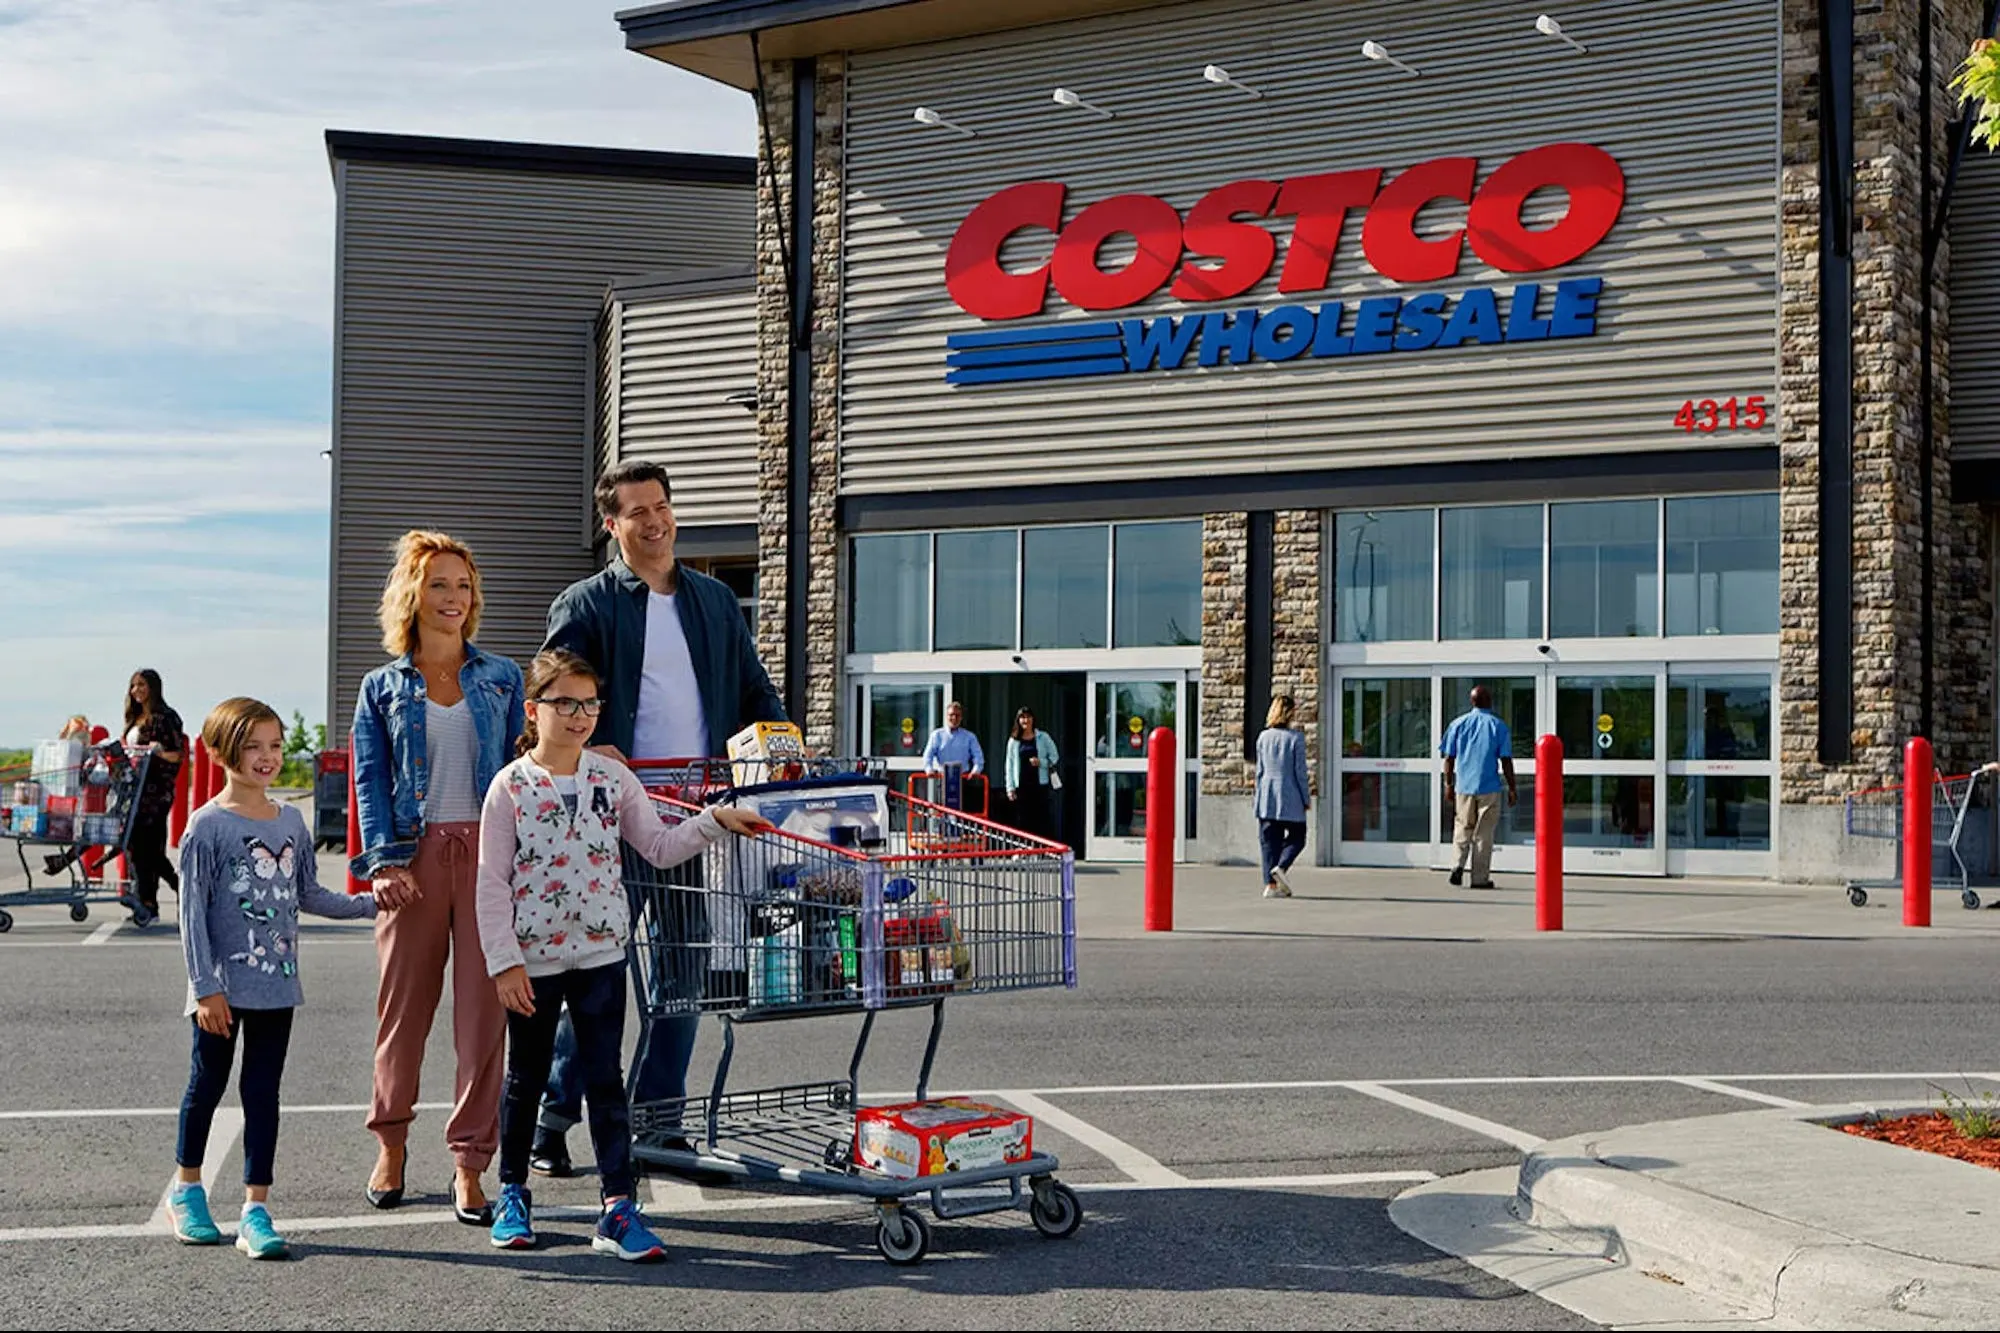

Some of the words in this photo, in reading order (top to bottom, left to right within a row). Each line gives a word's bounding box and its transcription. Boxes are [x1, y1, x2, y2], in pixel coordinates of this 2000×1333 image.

[945, 143, 1625, 320] COSTCO
[1122, 276, 1603, 373] WHOLESALE
[1673, 395, 1767, 434] 4315
